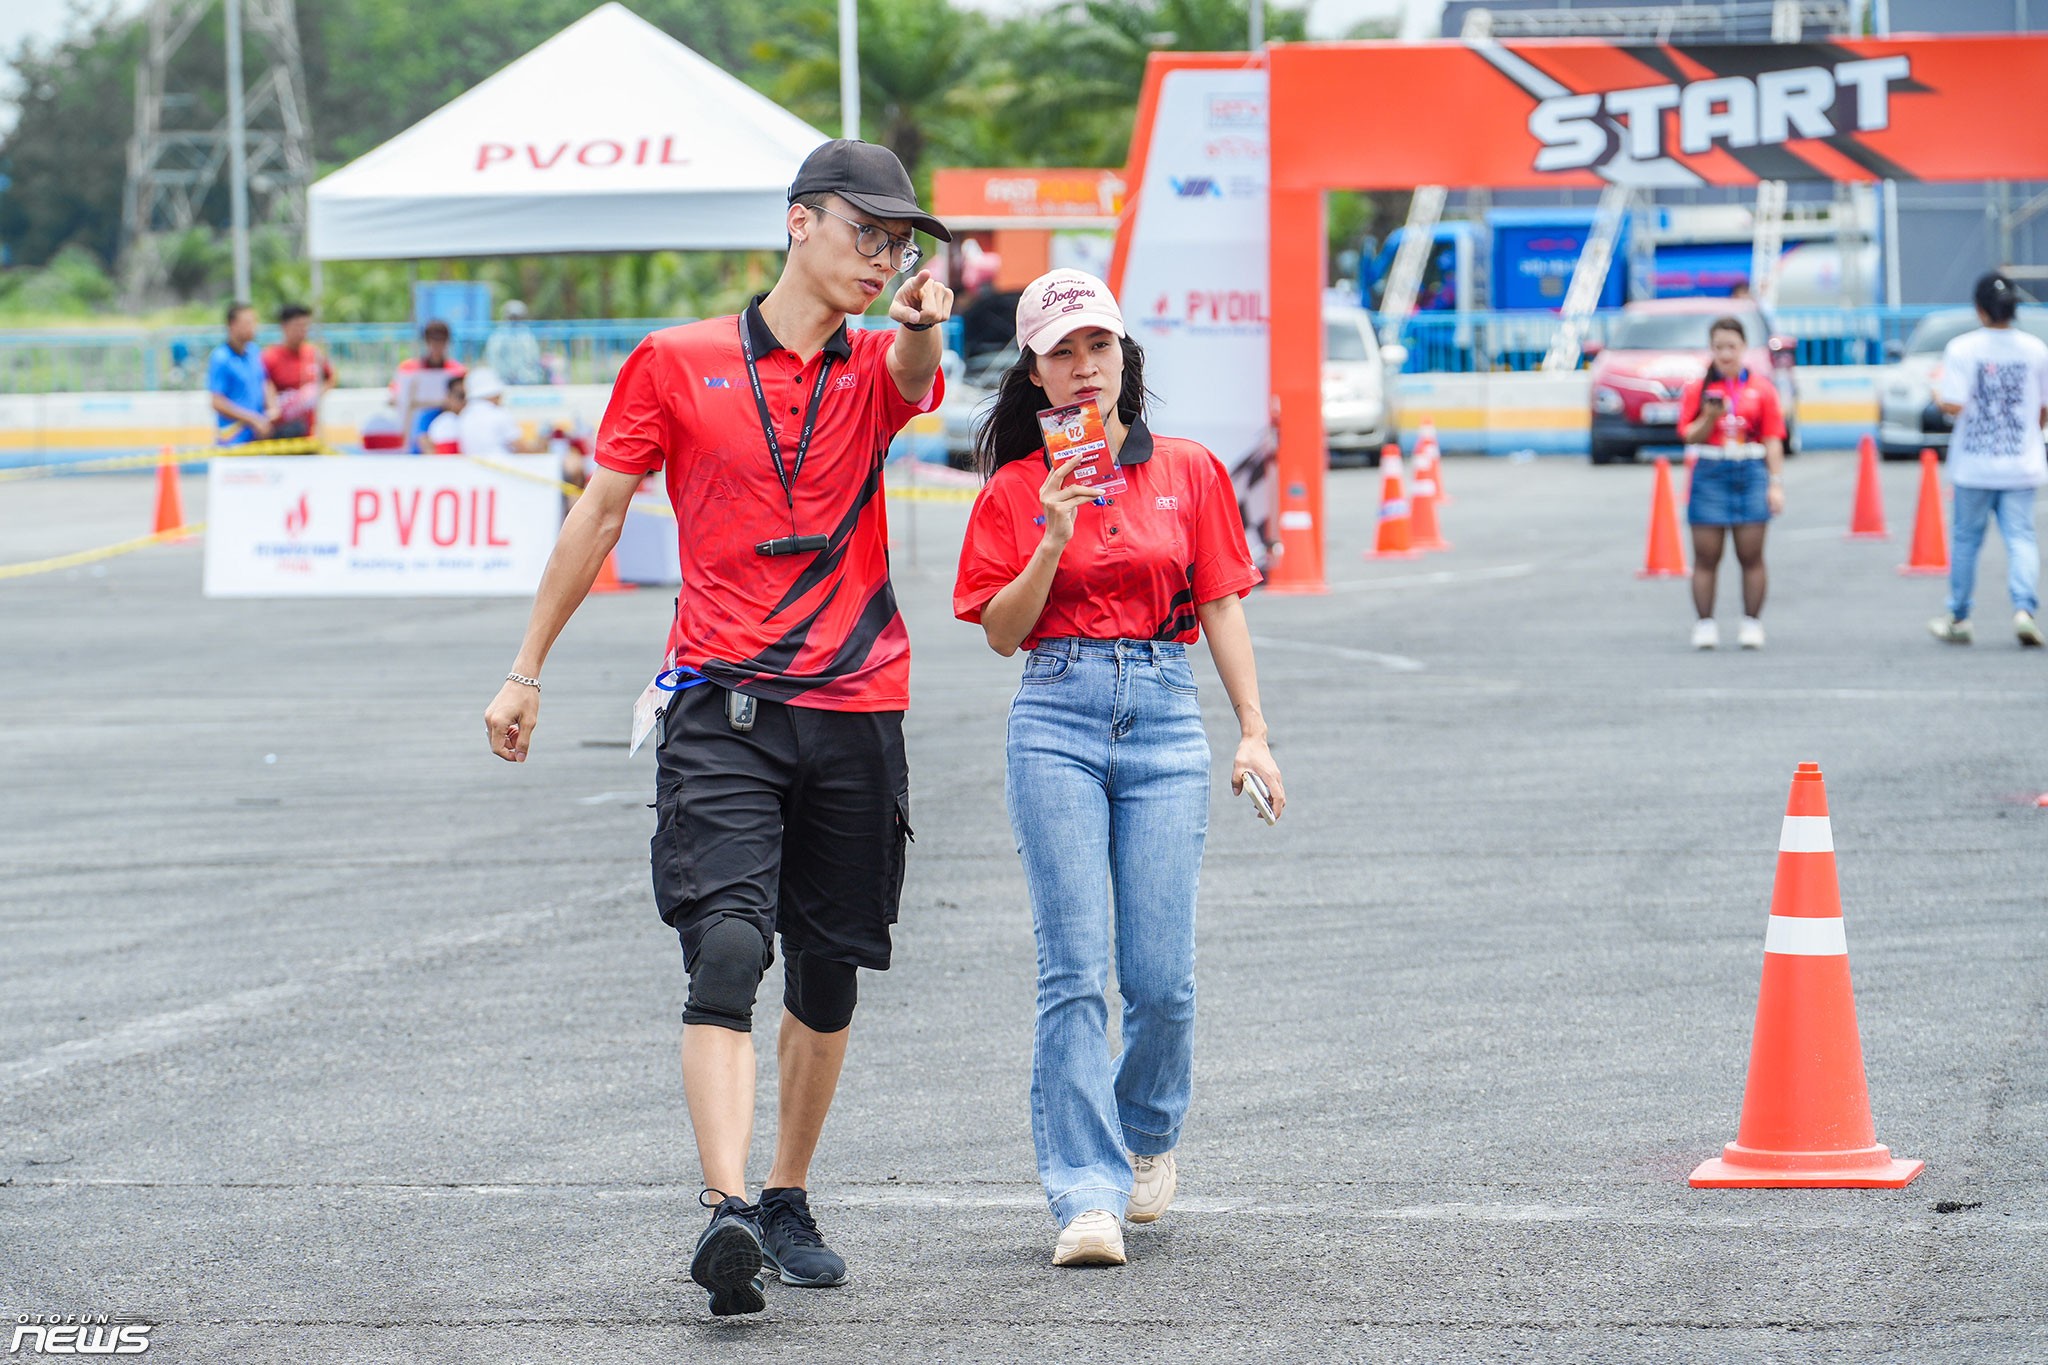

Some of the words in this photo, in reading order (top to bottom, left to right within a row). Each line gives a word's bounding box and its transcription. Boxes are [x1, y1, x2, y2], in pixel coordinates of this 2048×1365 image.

[1529, 55, 1911, 171] START
[475, 133, 690, 171] PVOIL
[1042, 288, 1096, 310] Dodgers
[1185, 290, 1270, 322] PVOIL
[1068, 426, 1081, 438] 24
[351, 488, 510, 547] PVOIL
